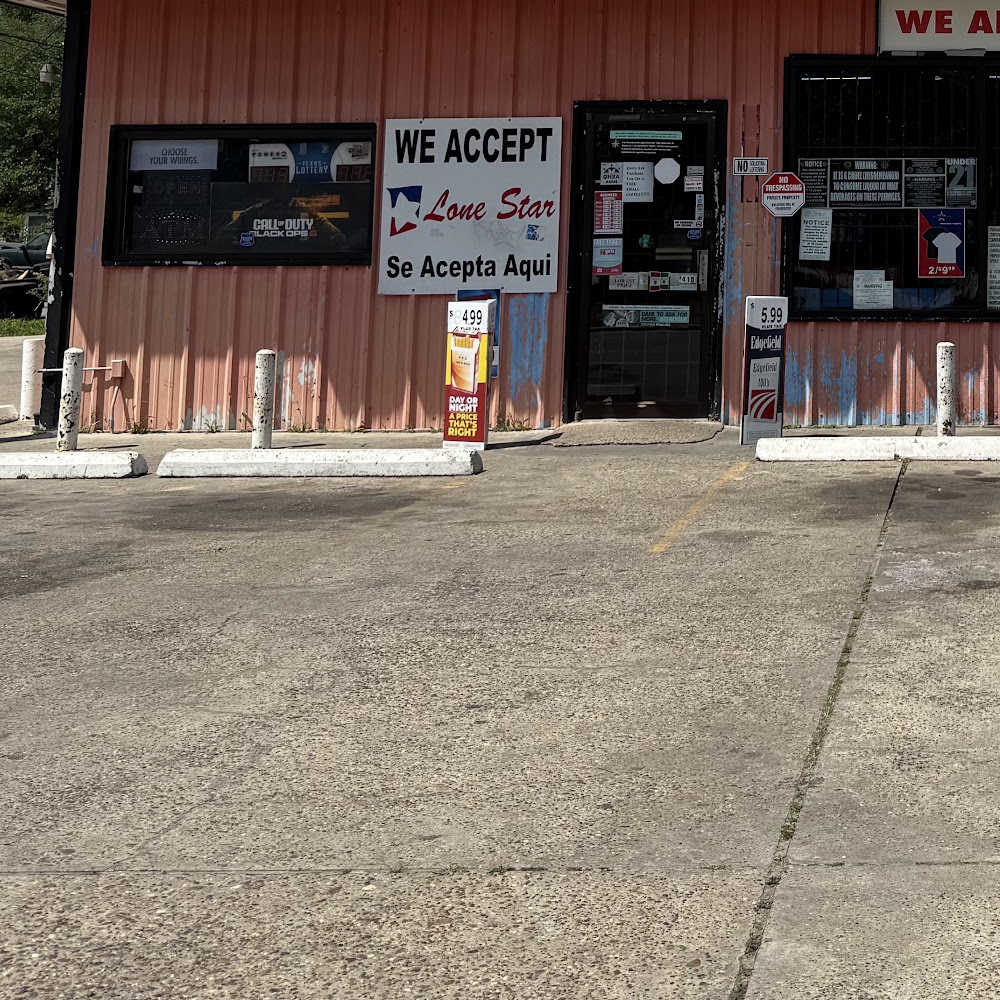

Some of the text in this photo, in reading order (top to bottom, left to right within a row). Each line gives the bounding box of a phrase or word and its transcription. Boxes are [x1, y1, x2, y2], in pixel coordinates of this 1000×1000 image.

[896, 10, 953, 35] WE
[395, 128, 436, 164] WE
[443, 127, 553, 163] ACCEPT
[161, 148, 188, 156] CHOOSE
[149, 156, 168, 164] YOUR
[737, 160, 748, 172] NO
[946, 158, 976, 166] UNDER
[296, 165, 329, 175] LOTTERY
[948, 165, 975, 188] 21
[765, 184, 803, 192] TRESPASSING
[423, 189, 487, 222] Lone
[496, 187, 556, 220] Star
[253, 218, 279, 230] CALL
[284, 218, 314, 230] DUTY
[386, 253, 551, 283] Se Acepta Aqui
[462, 309, 483, 325] 4.99
[761, 307, 783, 323] 5.99
[750, 335, 782, 351] Edgefield
[752, 362, 778, 374] Edgefield
[449, 395, 478, 404] DAY OR
[448, 403, 478, 412] NIGHT
[449, 420, 477, 428] THAT'S
[447, 428, 478, 437] RIGHT
